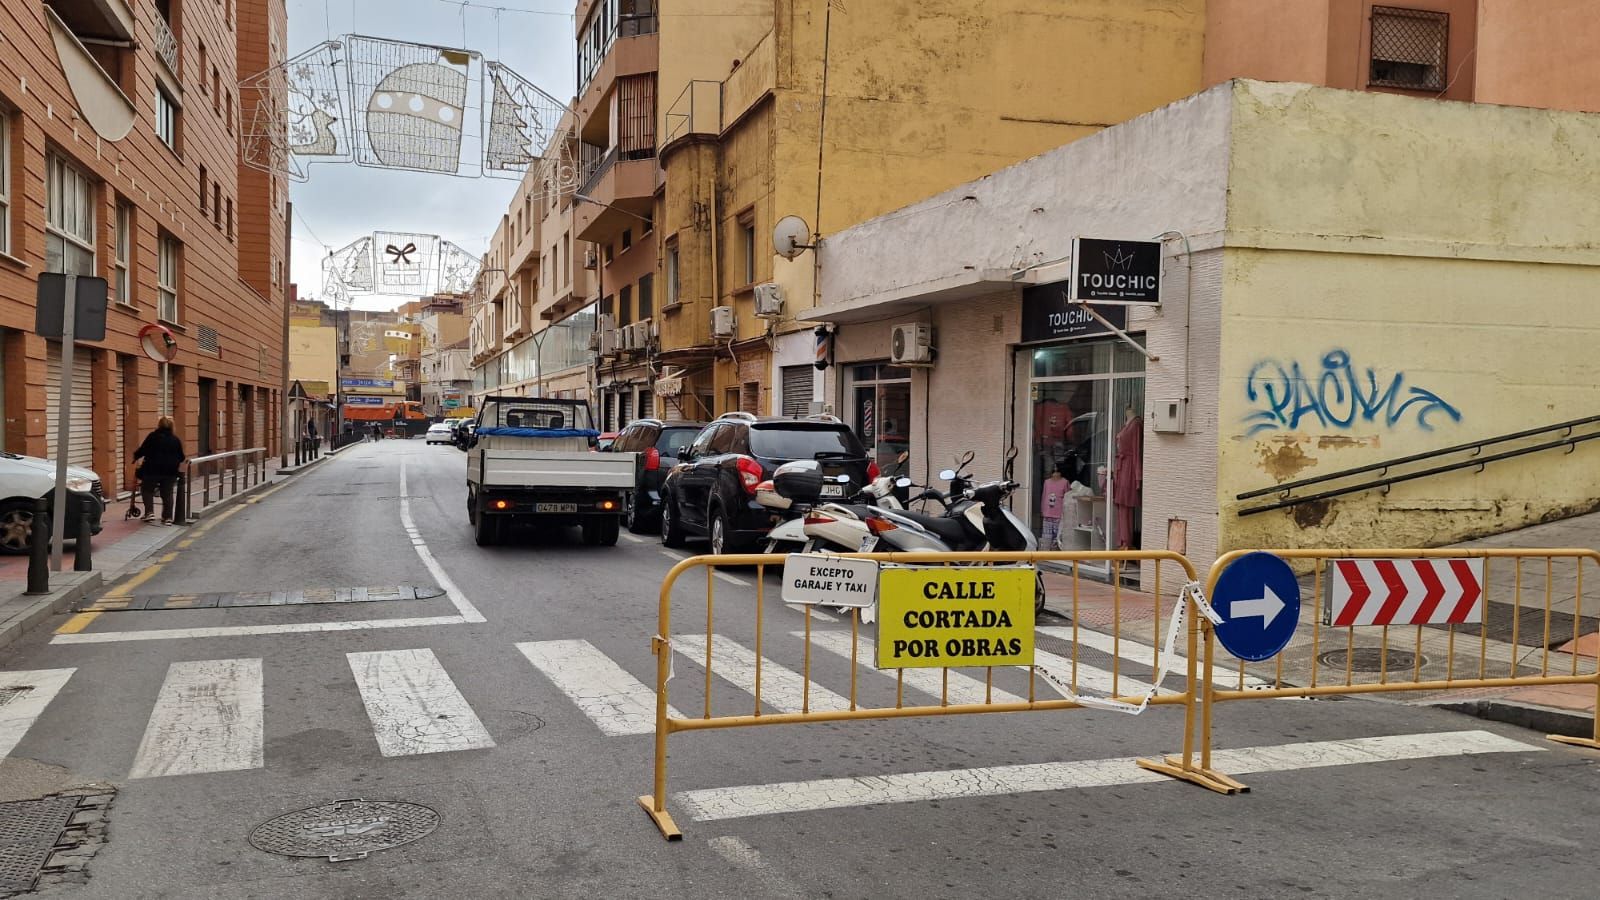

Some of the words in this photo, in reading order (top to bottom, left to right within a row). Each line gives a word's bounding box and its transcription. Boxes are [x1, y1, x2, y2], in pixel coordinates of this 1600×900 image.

[1081, 273, 1156, 289] TOUCHIC
[809, 566, 854, 579] EXCEPTO
[794, 579, 832, 591] GARAJE
[836, 581, 843, 591] Y
[845, 582, 867, 593] TAXI
[923, 581, 995, 599] CALLE
[903, 610, 1013, 629] CORTADA
[893, 639, 939, 658] POR
[945, 638, 1022, 657] OBRAS
